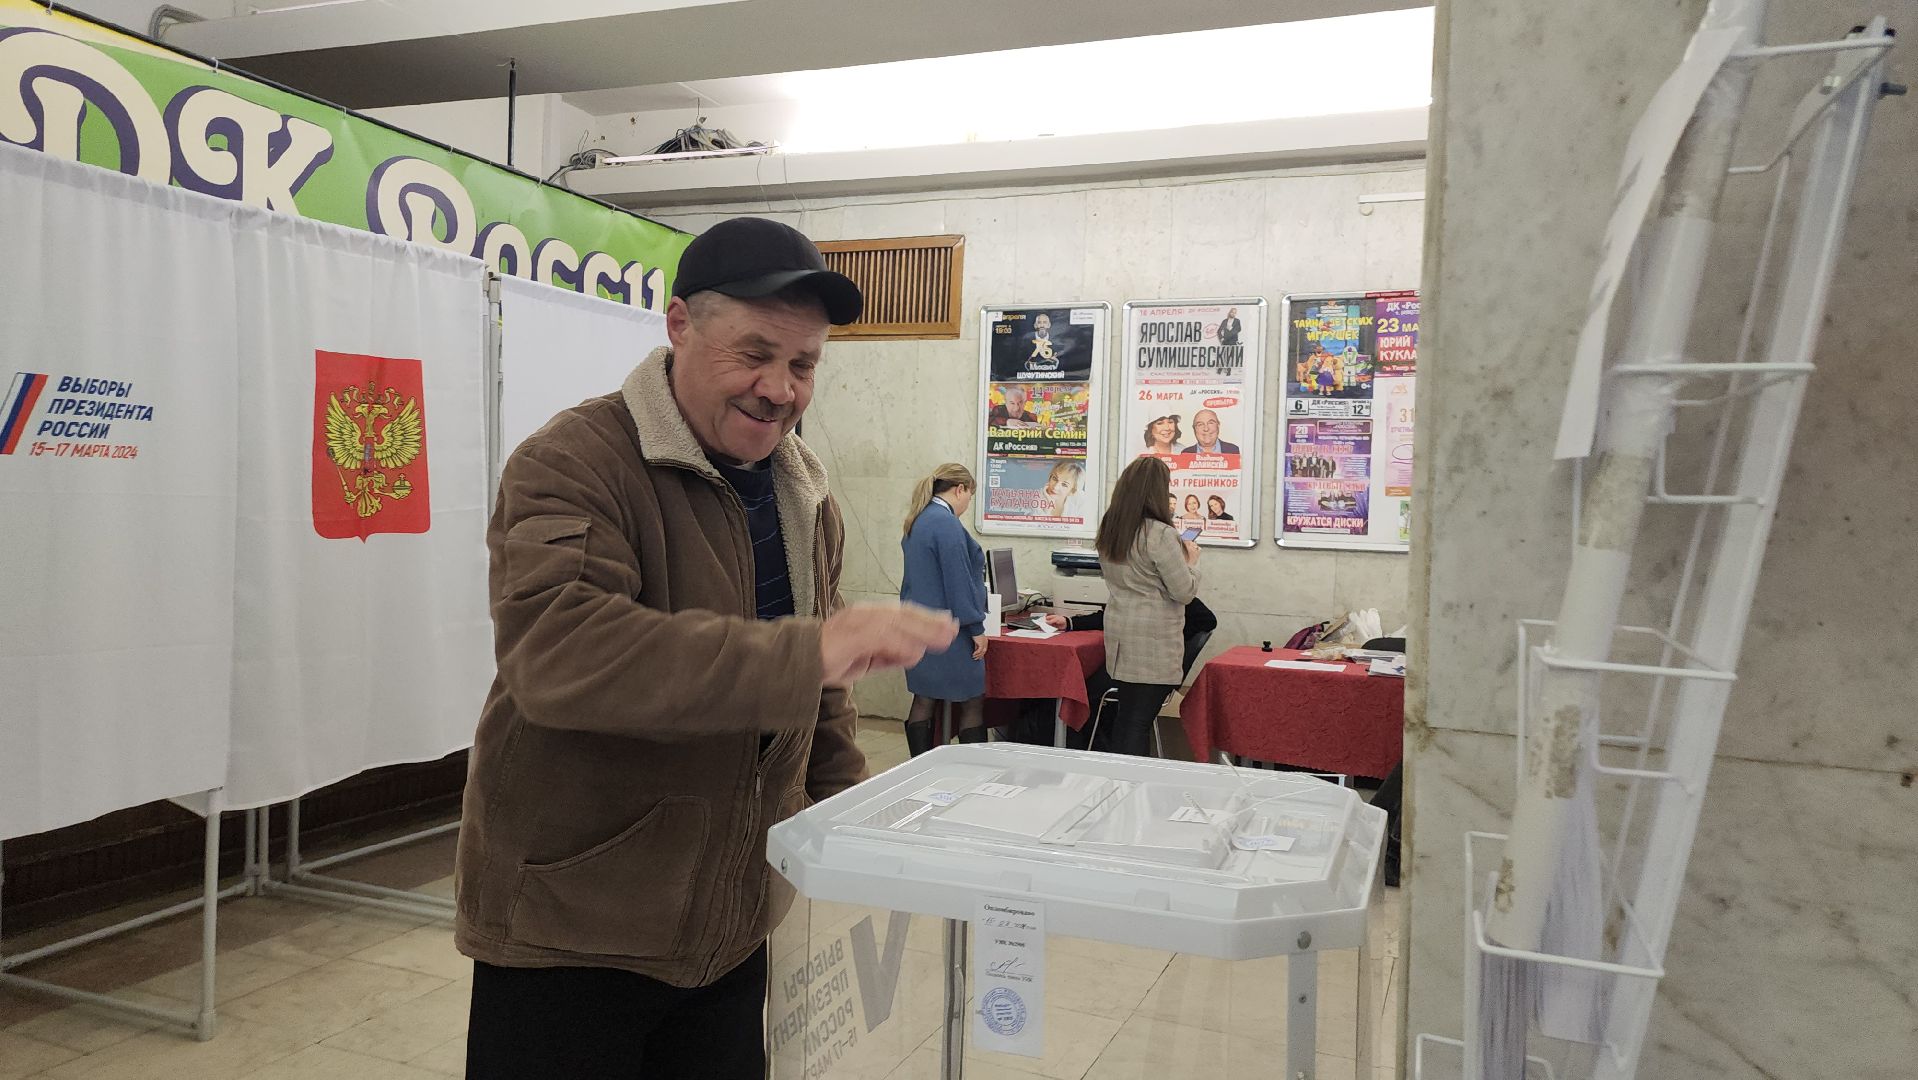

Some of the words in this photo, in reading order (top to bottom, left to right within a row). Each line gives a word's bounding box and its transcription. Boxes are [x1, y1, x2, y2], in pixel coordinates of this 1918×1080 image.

[366, 155, 668, 314] Росси
[1377, 317, 1399, 333] 23
[1402, 322, 1419, 332] МА
[1140, 321, 1202, 343] ЯРОСЛАВ
[1307, 329, 1359, 341] ИГРУШЕК
[1380, 335, 1410, 348] ЮРИЙ
[1138, 342, 1244, 368] СУМИШЕВСКИЙ
[1380, 349, 1418, 361] КУКЛА
[57, 375, 133, 398] ВЫБОРЫ
[1138, 390, 1152, 400] 26
[1156, 392, 1183, 400] МАРТА
[47, 398, 154, 422] ПРЕЗИДЕНТА
[1295, 399, 1303, 410] 6
[1352, 404, 1363, 414] 12
[36, 420, 111, 439] РОССИИ
[989, 426, 1042, 440] Валерий
[70, 443, 110, 458] МАРТА
[111, 445, 138, 459] 2024
[993, 441, 1004, 450] ДК
[1183, 478, 1238, 488] ГРЕШНИКОВ
[1287, 515, 1332, 527] КРУЖАТСЯ
[1335, 518, 1364, 528] ДИСКИ
